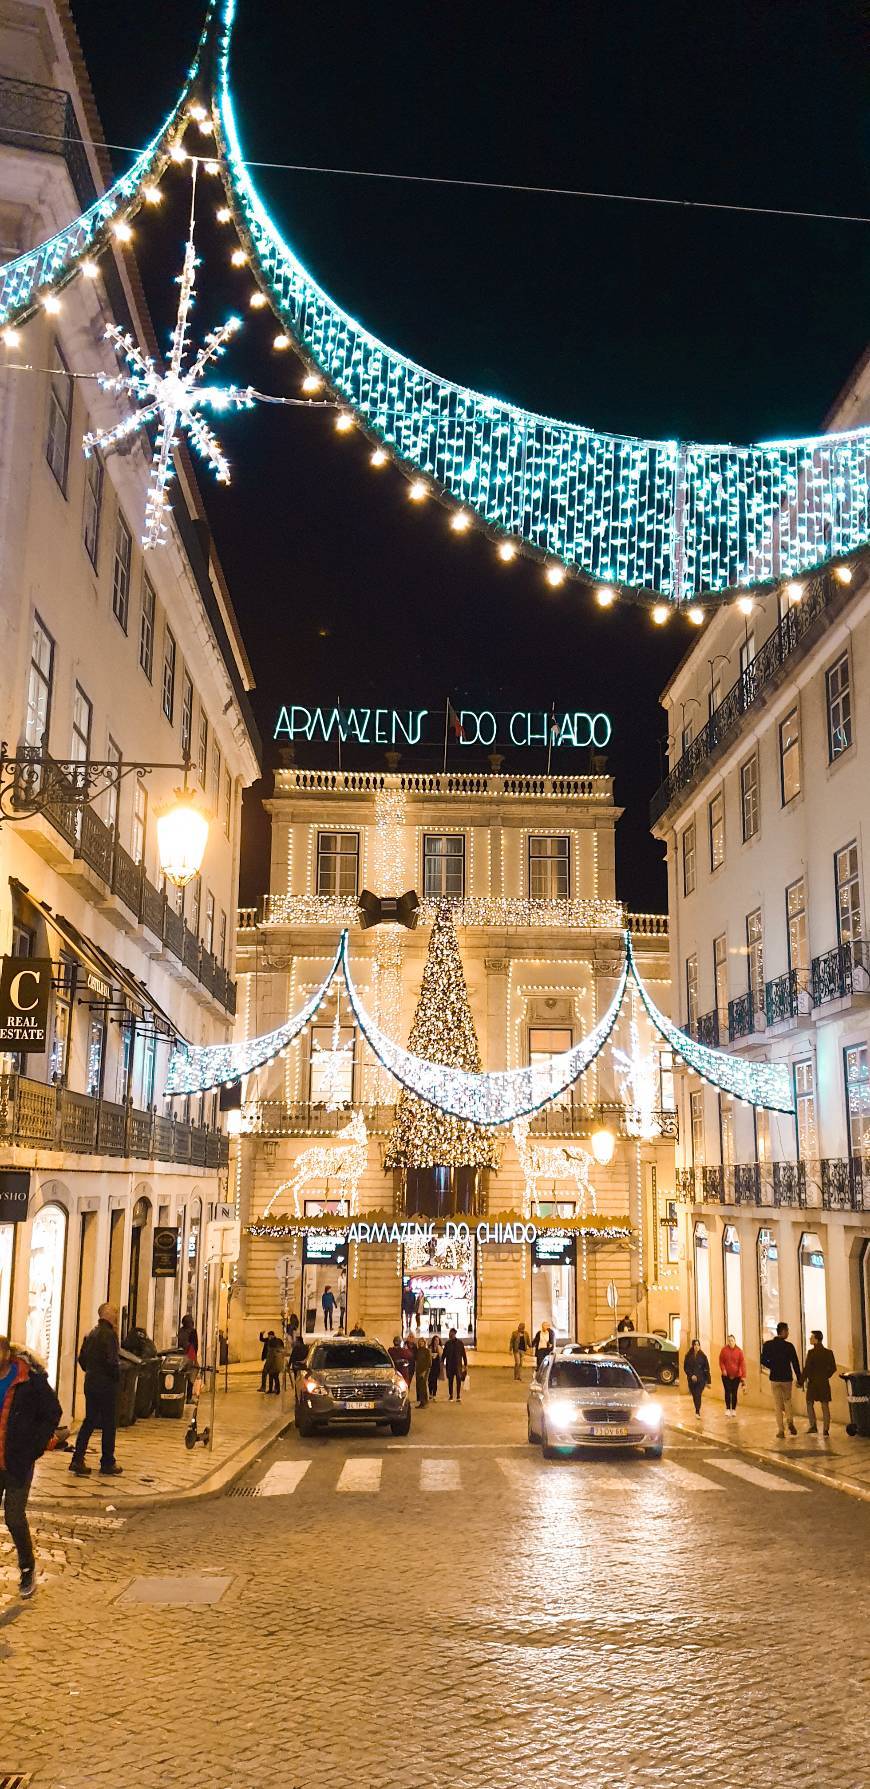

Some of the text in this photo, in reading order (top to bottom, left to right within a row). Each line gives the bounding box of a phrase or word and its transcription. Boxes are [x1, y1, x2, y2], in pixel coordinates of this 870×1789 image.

[273, 705, 612, 748] ARMAZENS DO CHIADO
[9, 970, 41, 1011] C
[6, 1016, 38, 1028] REAL
[0, 1028, 45, 1040] ESTATE
[347, 1222, 537, 1244] ARMAZENS DO CHIADO
